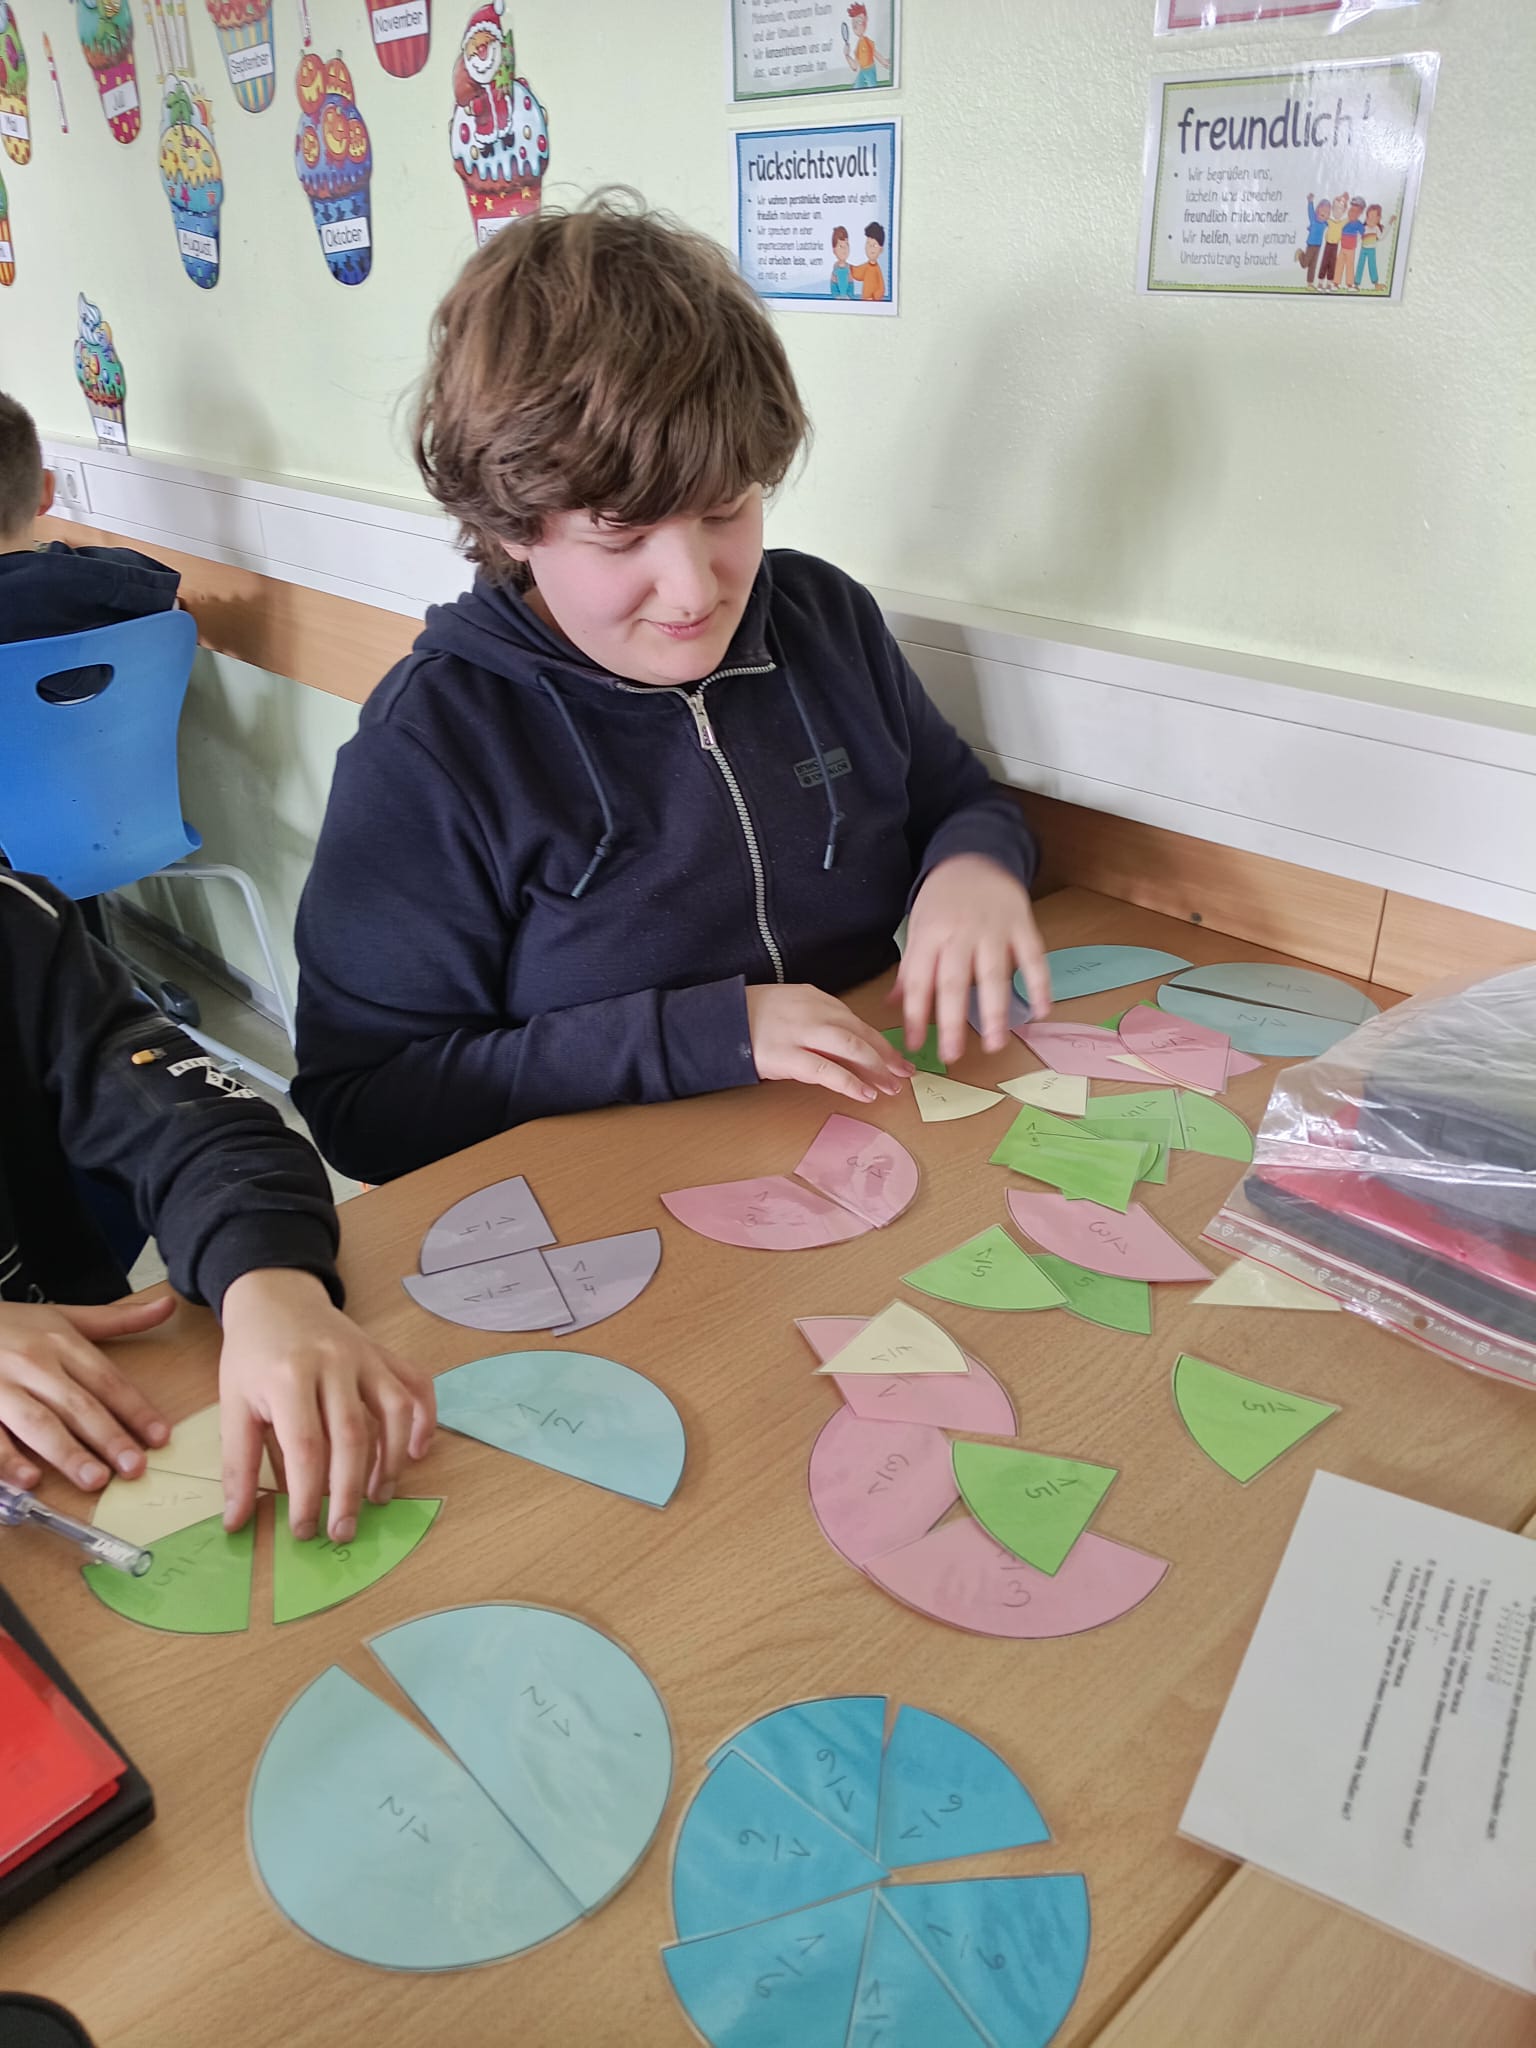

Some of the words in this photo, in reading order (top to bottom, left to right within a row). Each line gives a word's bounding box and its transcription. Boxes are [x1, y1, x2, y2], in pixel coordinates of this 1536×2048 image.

[376, 10, 423, 33] November
[231, 54, 269, 75] September
[1188, 167, 1203, 181] Wir
[1207, 166, 1249, 184] begrüßen
[1184, 209, 1227, 223] freundlich
[325, 227, 362, 247] Oktober
[1183, 229, 1197, 243] Wir
[1235, 232, 1258, 244] wenn
[1262, 230, 1296, 246] jemand
[183, 239, 213, 257] August
